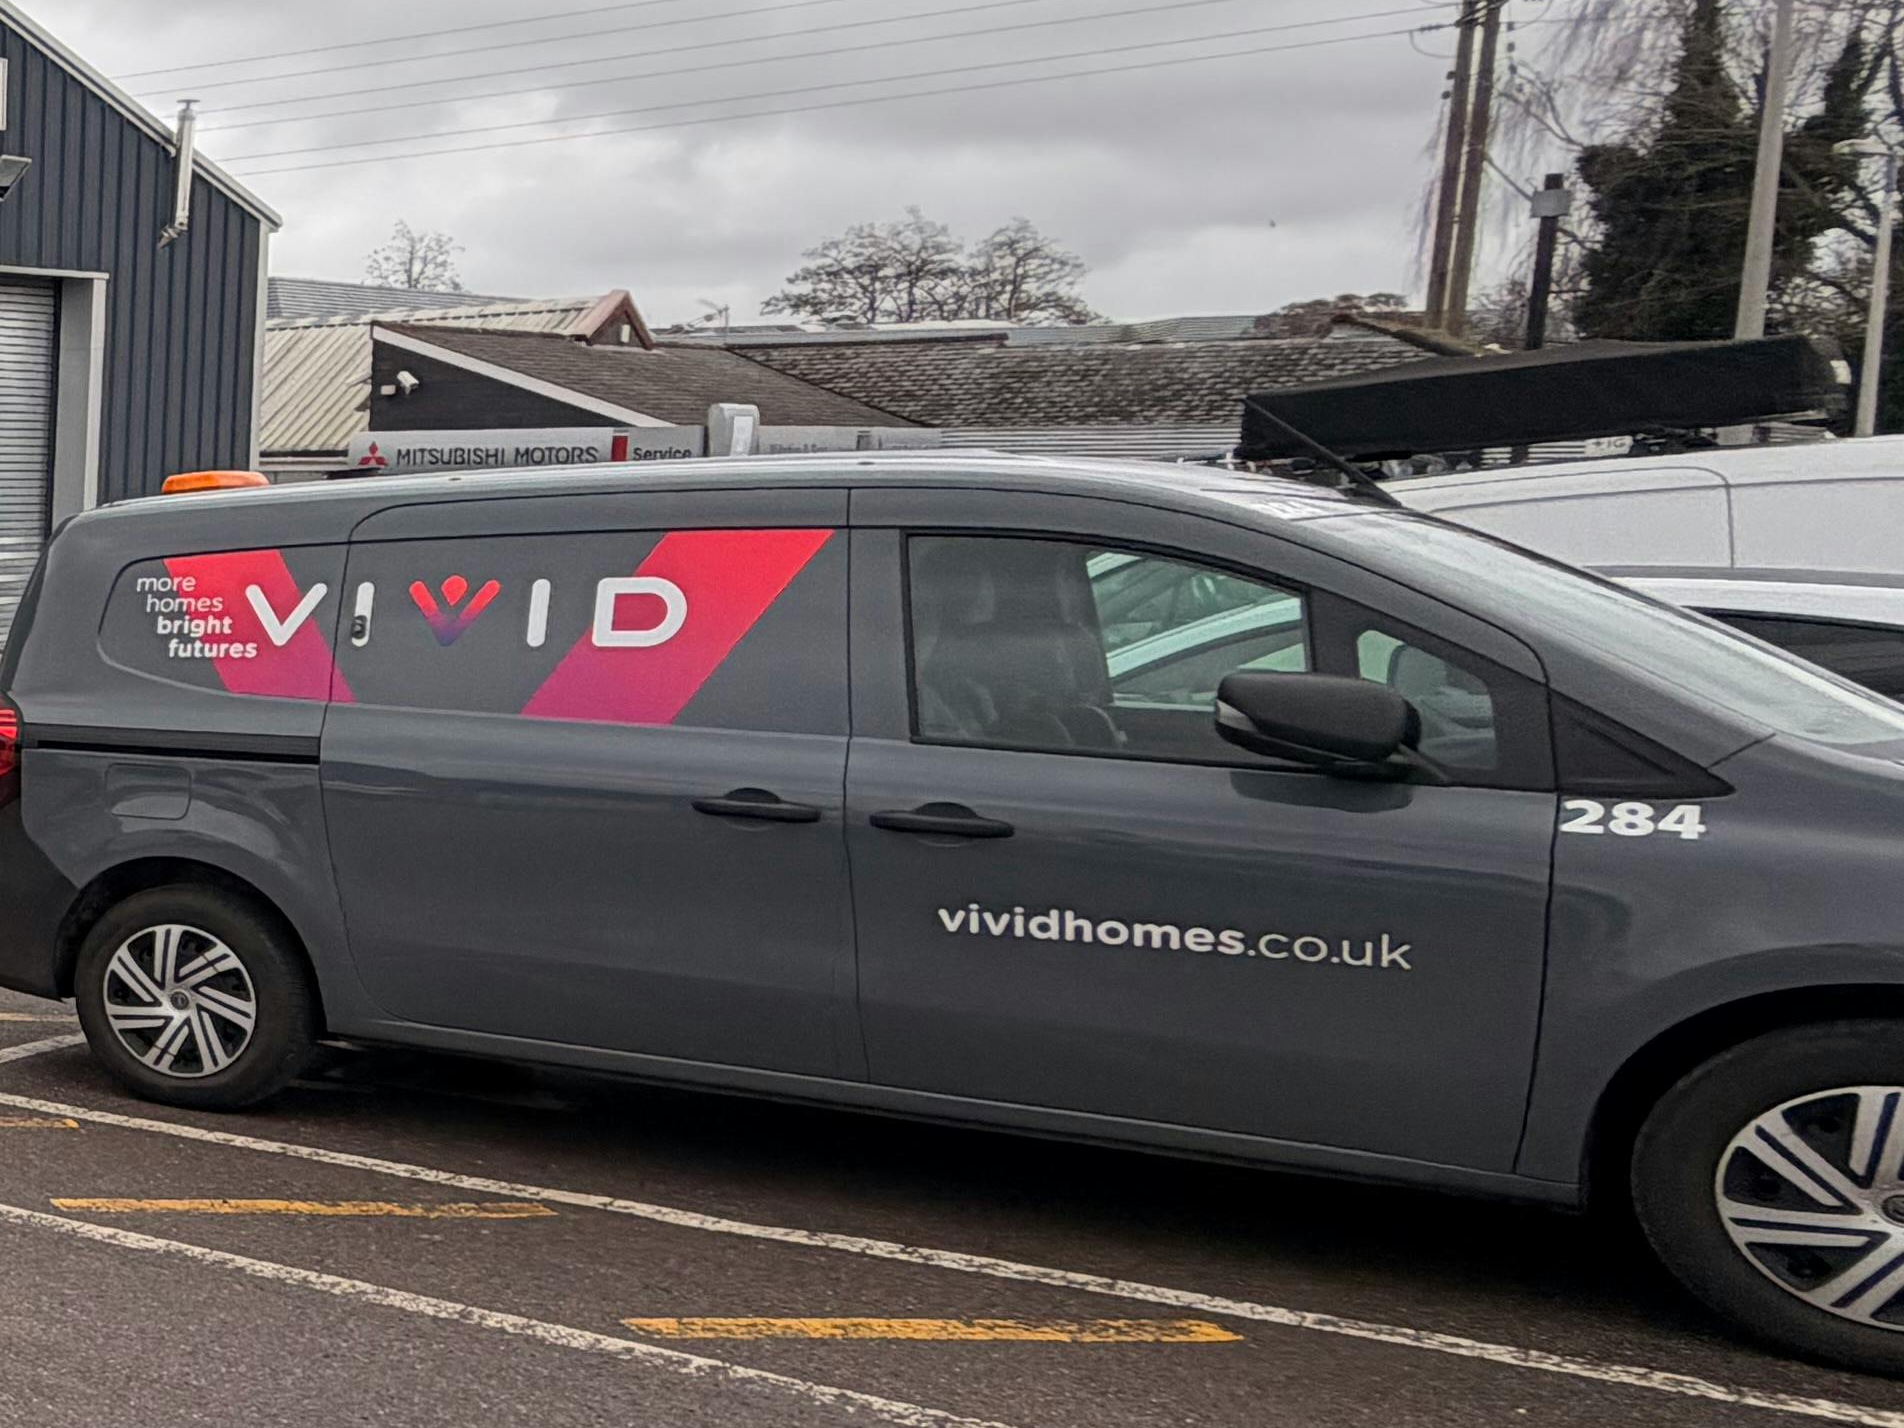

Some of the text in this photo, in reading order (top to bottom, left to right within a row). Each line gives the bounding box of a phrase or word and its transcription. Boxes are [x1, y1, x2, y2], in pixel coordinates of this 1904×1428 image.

[396, 446, 506, 467] MITSUBISHI
[514, 445, 599, 465] MOTORS
[136, 575, 196, 592] more
[145, 593, 224, 613] homes
[244, 575, 688, 648] VIVID
[156, 615, 233, 637] bright
[168, 638, 258, 658] futures
[1558, 799, 1707, 840] 284
[938, 903, 1413, 971] vividhomes.co.uk
